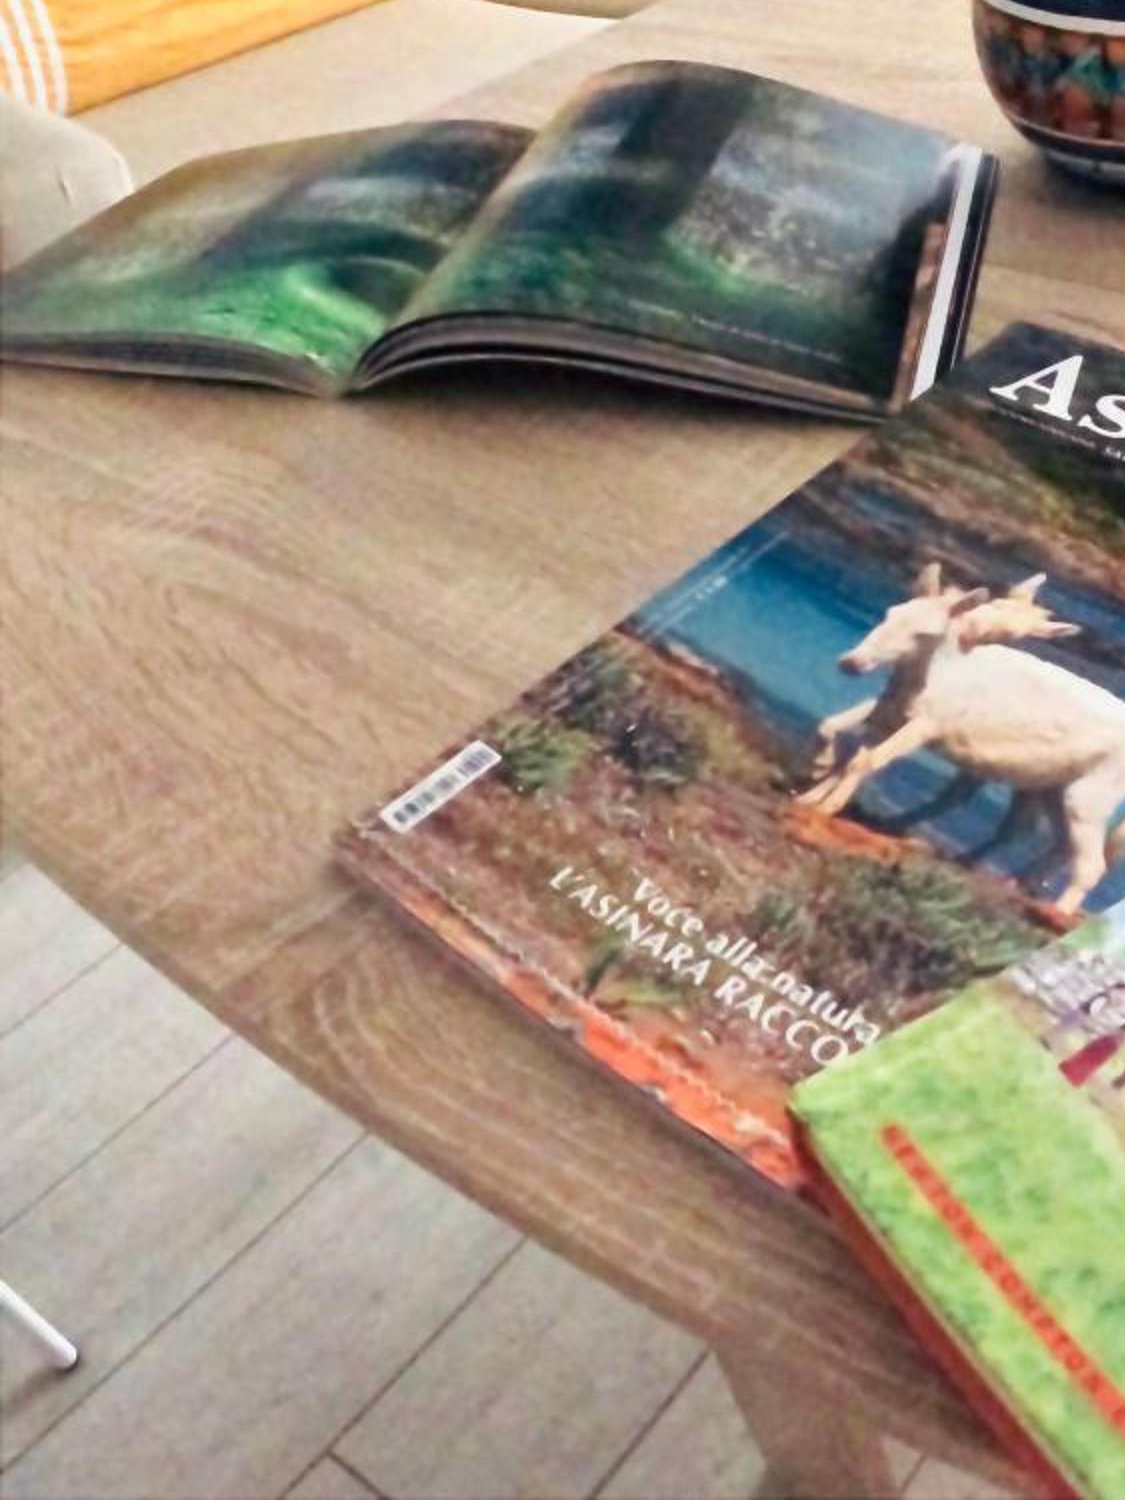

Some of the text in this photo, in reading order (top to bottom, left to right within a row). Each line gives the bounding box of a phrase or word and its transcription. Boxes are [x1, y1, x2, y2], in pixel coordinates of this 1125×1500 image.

[550, 866, 712, 986] L'ASINARA
[633, 875, 704, 937] Voce
[705, 932, 770, 979] alla
